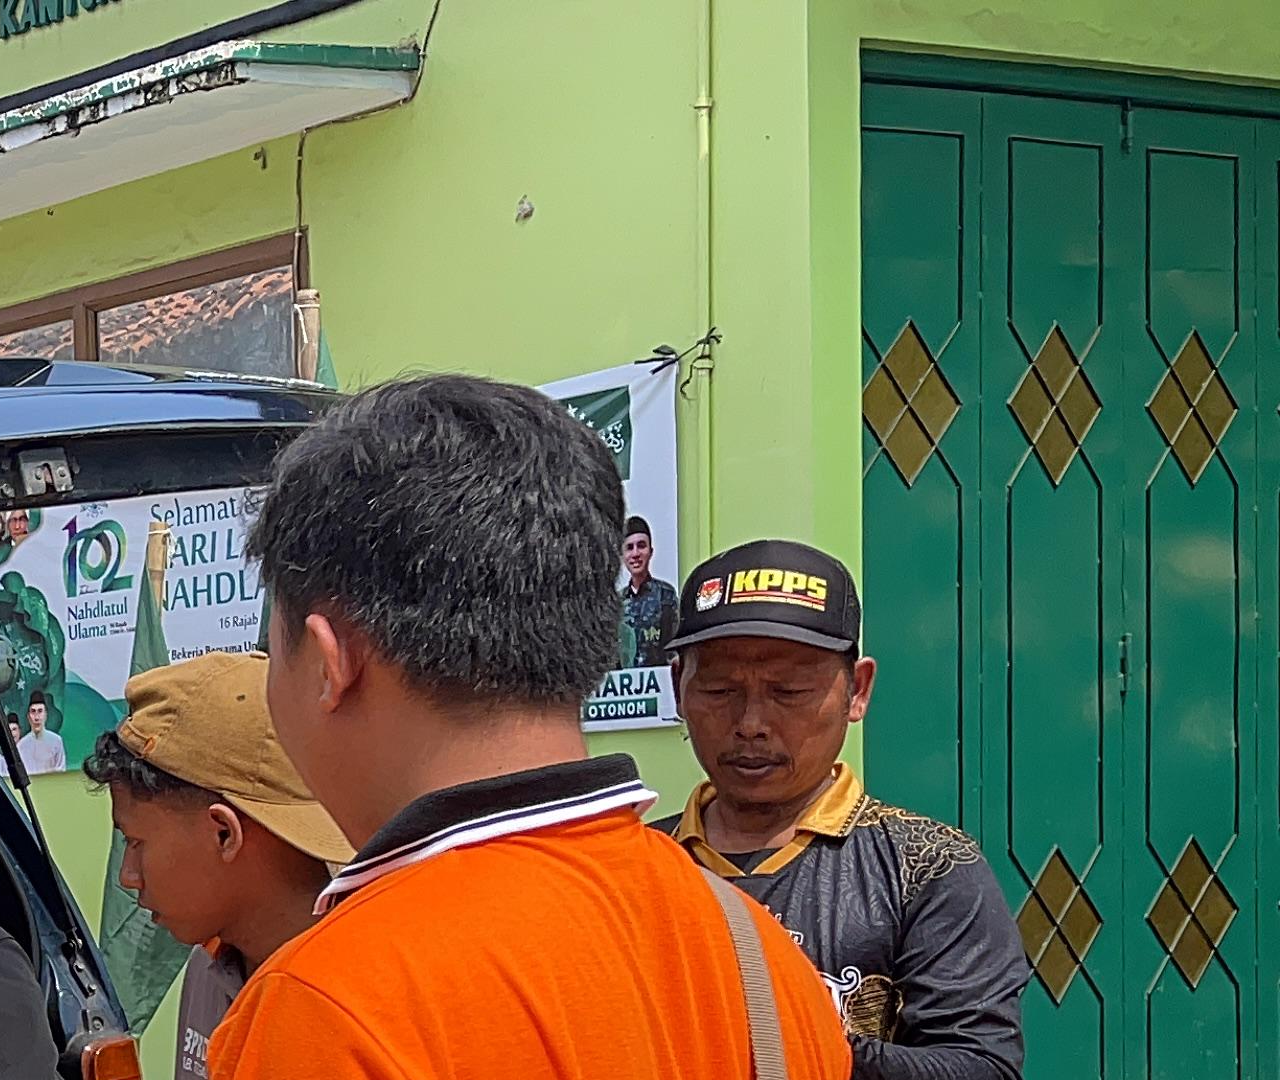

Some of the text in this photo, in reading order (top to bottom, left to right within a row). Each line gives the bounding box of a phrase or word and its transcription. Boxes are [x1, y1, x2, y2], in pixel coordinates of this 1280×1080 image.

[151, 498, 239, 528] Selamat
[61, 515, 134, 598] 102
[165, 528, 217, 570] ARI
[733, 568, 828, 599] KPPS
[67, 596, 128, 621] Nahdlatul
[220, 612, 259, 630] 16 Rajab
[68, 622, 108, 640] Ulama
[596, 670, 661, 698] ARJA
[588, 701, 647, 718] OTONOM
